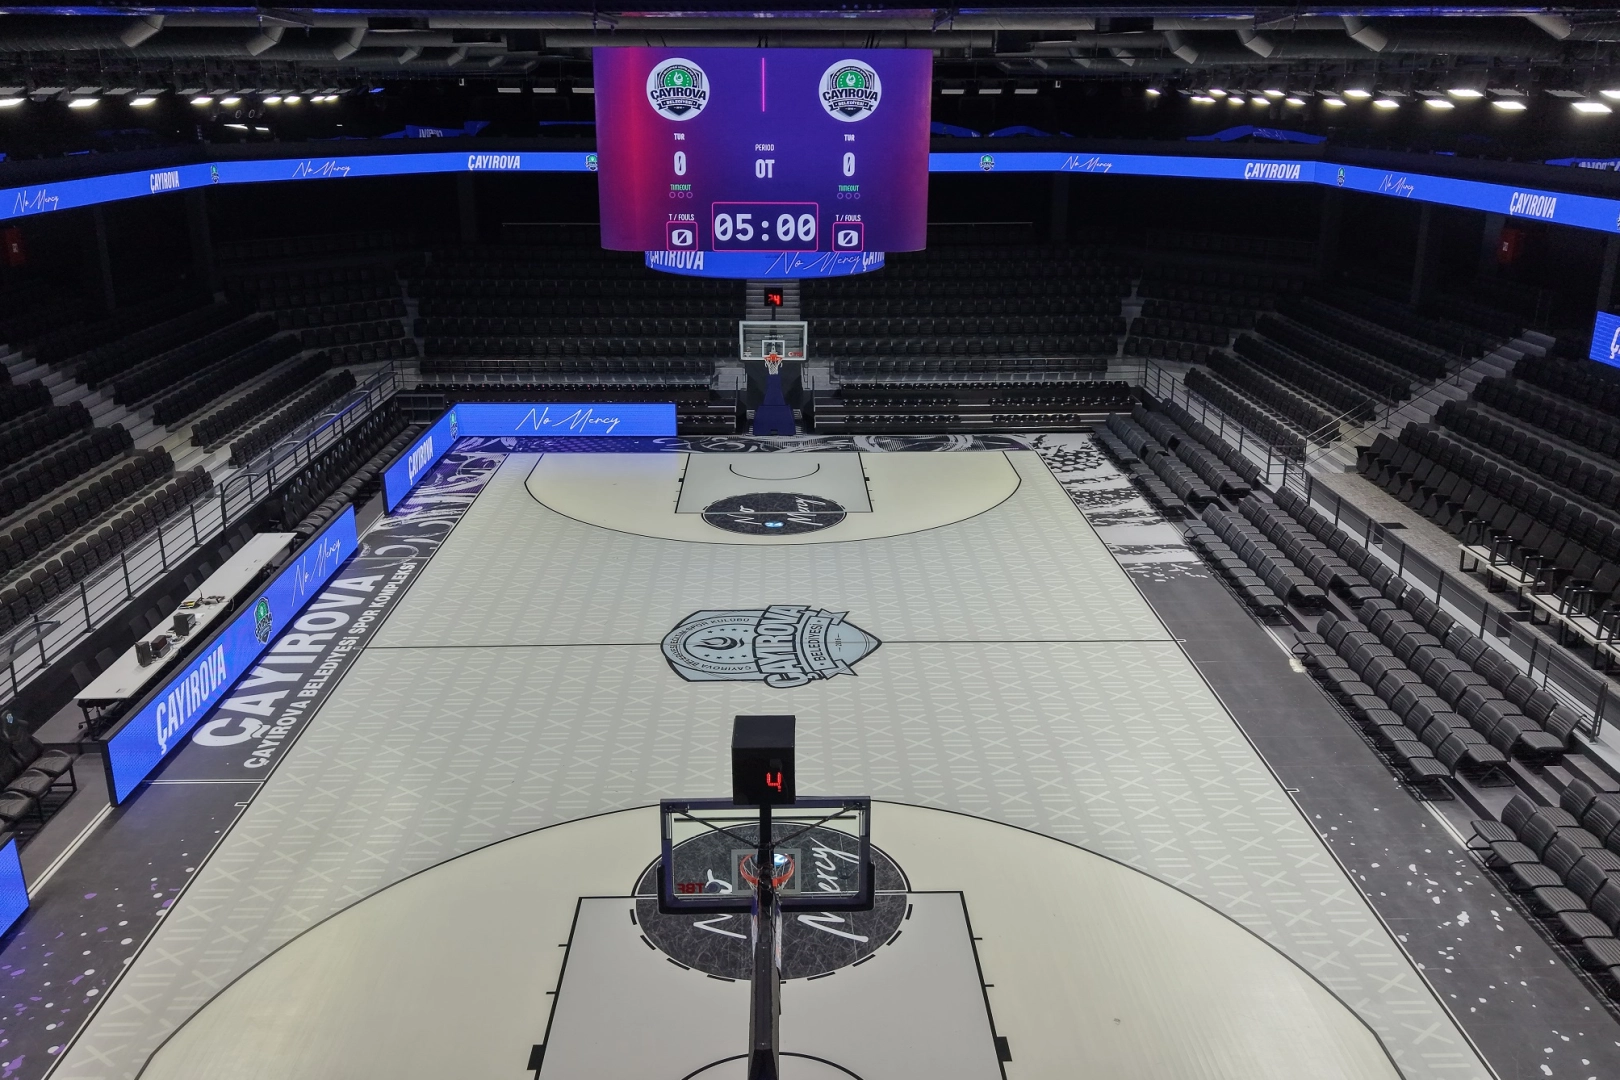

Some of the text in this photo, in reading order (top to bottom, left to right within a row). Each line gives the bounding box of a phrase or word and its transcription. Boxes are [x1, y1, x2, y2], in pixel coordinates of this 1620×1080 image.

[650, 87, 707, 103] ÇAYIROVA
[822, 88, 878, 103] ÇAYIROVA
[755, 143, 775, 152] PERIOD
[292, 160, 351, 178] No Mercy
[467, 154, 521, 171] ÇAYIROVA
[673, 151, 687, 176] 0
[755, 158, 775, 178] OT
[843, 152, 856, 177] 0
[1060, 155, 1113, 174] No Mercy
[1244, 162, 1301, 180] ÇAYIROVA
[150, 170, 180, 194] ÇAYIROVA
[670, 183, 692, 191] TIMEOUT
[838, 184, 860, 192] TIMEOUT
[1378, 174, 1415, 198] No Mercy
[13, 189, 59, 214] No Mercy
[1509, 191, 1558, 219] ÇAYIROVA
[669, 213, 673, 221] T
[678, 213, 695, 221] FOULS
[714, 213, 816, 242] 05:00
[835, 214, 840, 222] T
[845, 214, 862, 222] FOULS
[671, 229, 693, 247] 0
[837, 229, 859, 247] 0
[514, 406, 621, 434] No Mercy
[408, 435, 434, 486] ÇAYIROVA
[291, 537, 341, 608] No Mercy
[754, 604, 821, 688] ÇAYIROVA
[804, 623, 827, 662] BELEDİYESİ
[191, 574, 386, 747] ÇAYIROVA
[156, 643, 227, 755] ÇAYIROVA
[243, 699, 312, 769] ÇAYIROVA
[347, 606, 381, 635] SPOR
